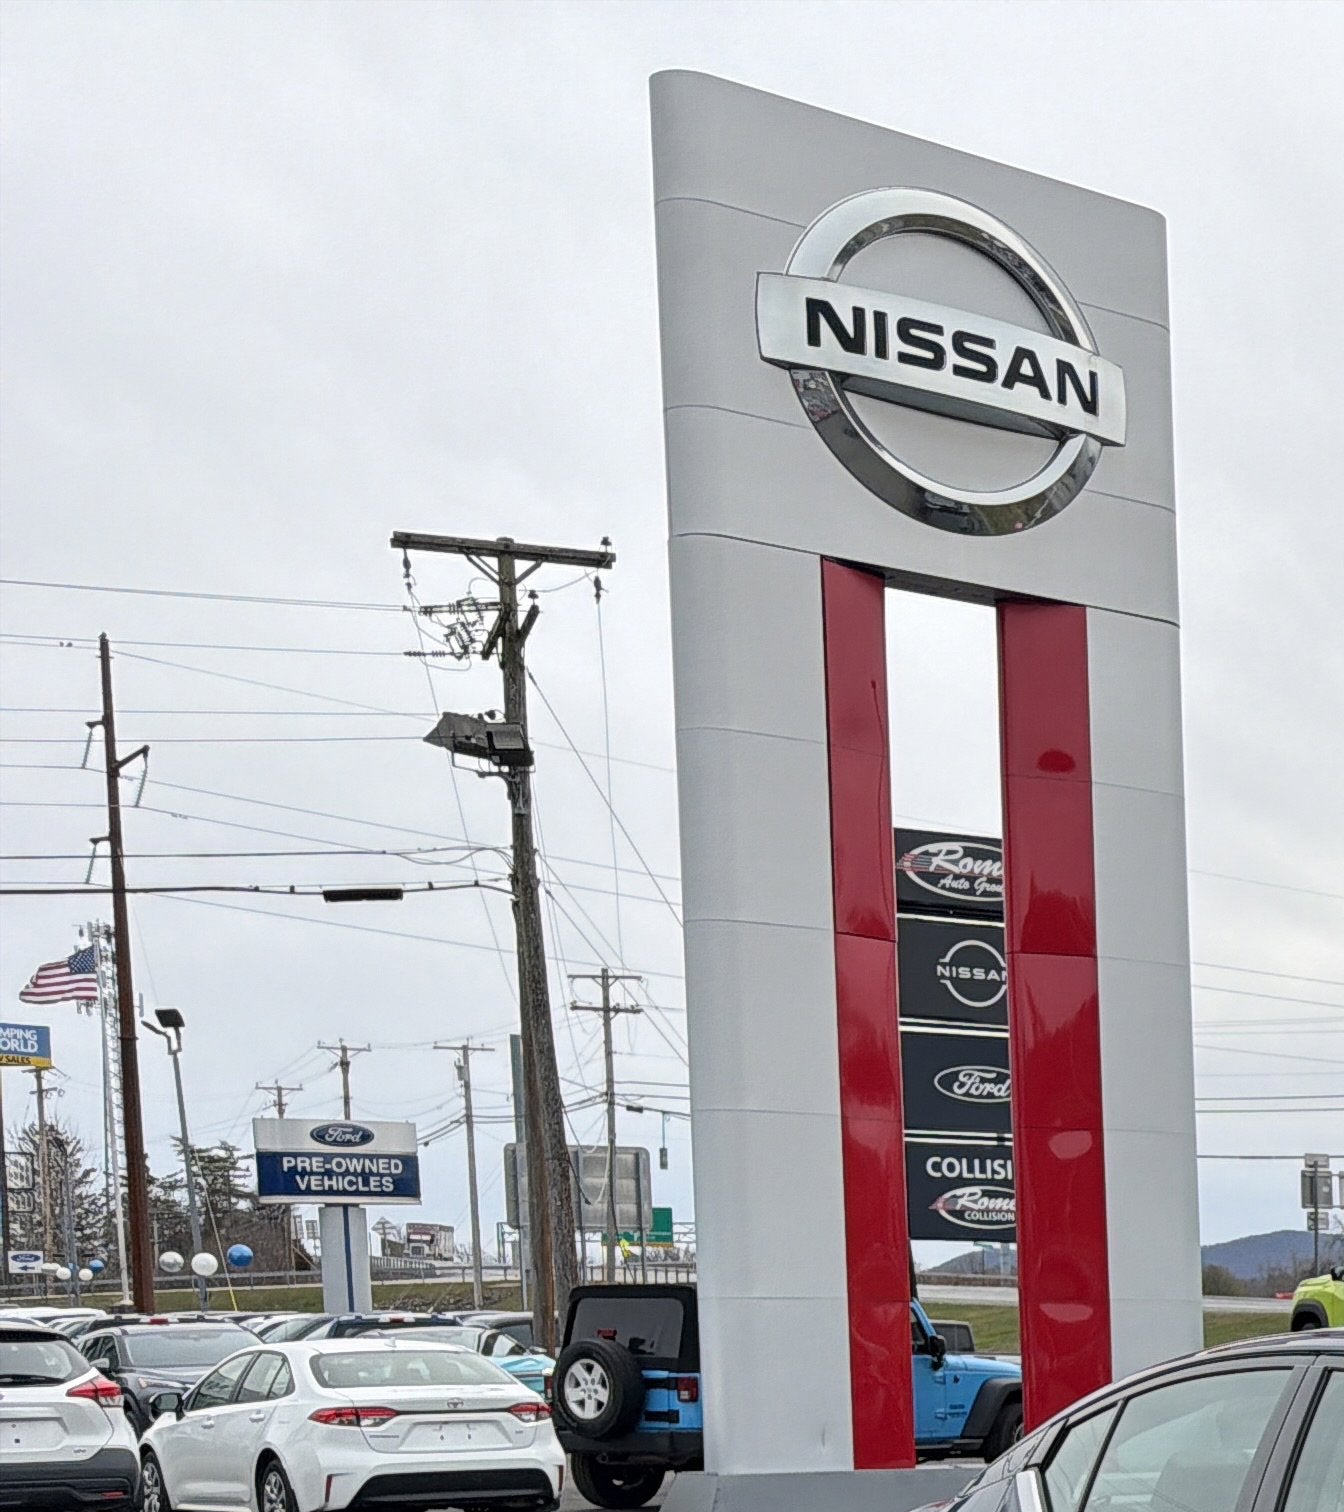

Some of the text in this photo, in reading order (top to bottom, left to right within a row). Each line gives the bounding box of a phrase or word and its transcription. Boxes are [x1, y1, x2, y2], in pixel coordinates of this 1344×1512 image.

[805, 297, 1099, 417] NISSAN
[928, 845, 1003, 877] Rom
[938, 874, 970, 889] Auto
[0, 1027, 38, 1041] MPING
[0, 1038, 39, 1053] ORLD
[953, 1069, 1011, 1097] Ford
[325, 1126, 362, 1142] Ford
[282, 1156, 403, 1174] PRE-OWNED
[926, 1156, 1013, 1180] COLLISI
[295, 1175, 394, 1192] VEHICLES
[956, 1188, 1016, 1211] Rome
[964, 1210, 1016, 1221] COLLISION
